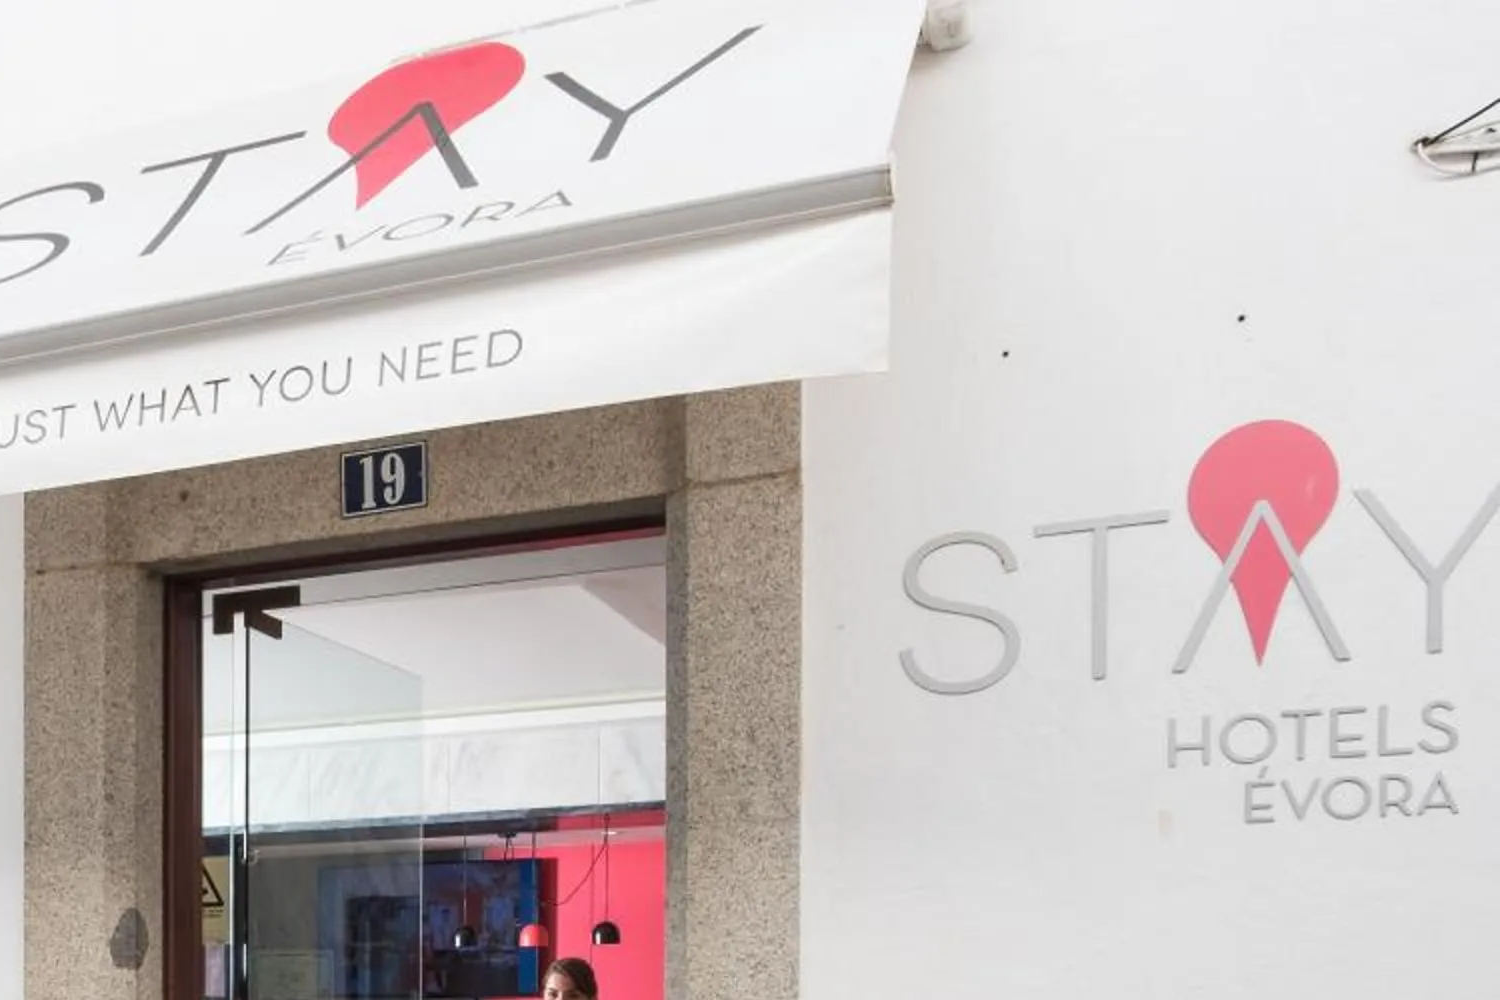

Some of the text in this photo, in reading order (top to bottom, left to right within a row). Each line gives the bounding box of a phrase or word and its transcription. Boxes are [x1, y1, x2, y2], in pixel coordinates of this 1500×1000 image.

[267, 188, 575, 268] ÉVORA
[93, 377, 232, 433] WHAT
[248, 355, 354, 408] YOU
[376, 328, 524, 388] NEED
[359, 450, 406, 511] 19
[899, 478, 1500, 696] STAY
[1166, 700, 1460, 768] HOTELS
[1244, 766, 1460, 824] ÉVORA
